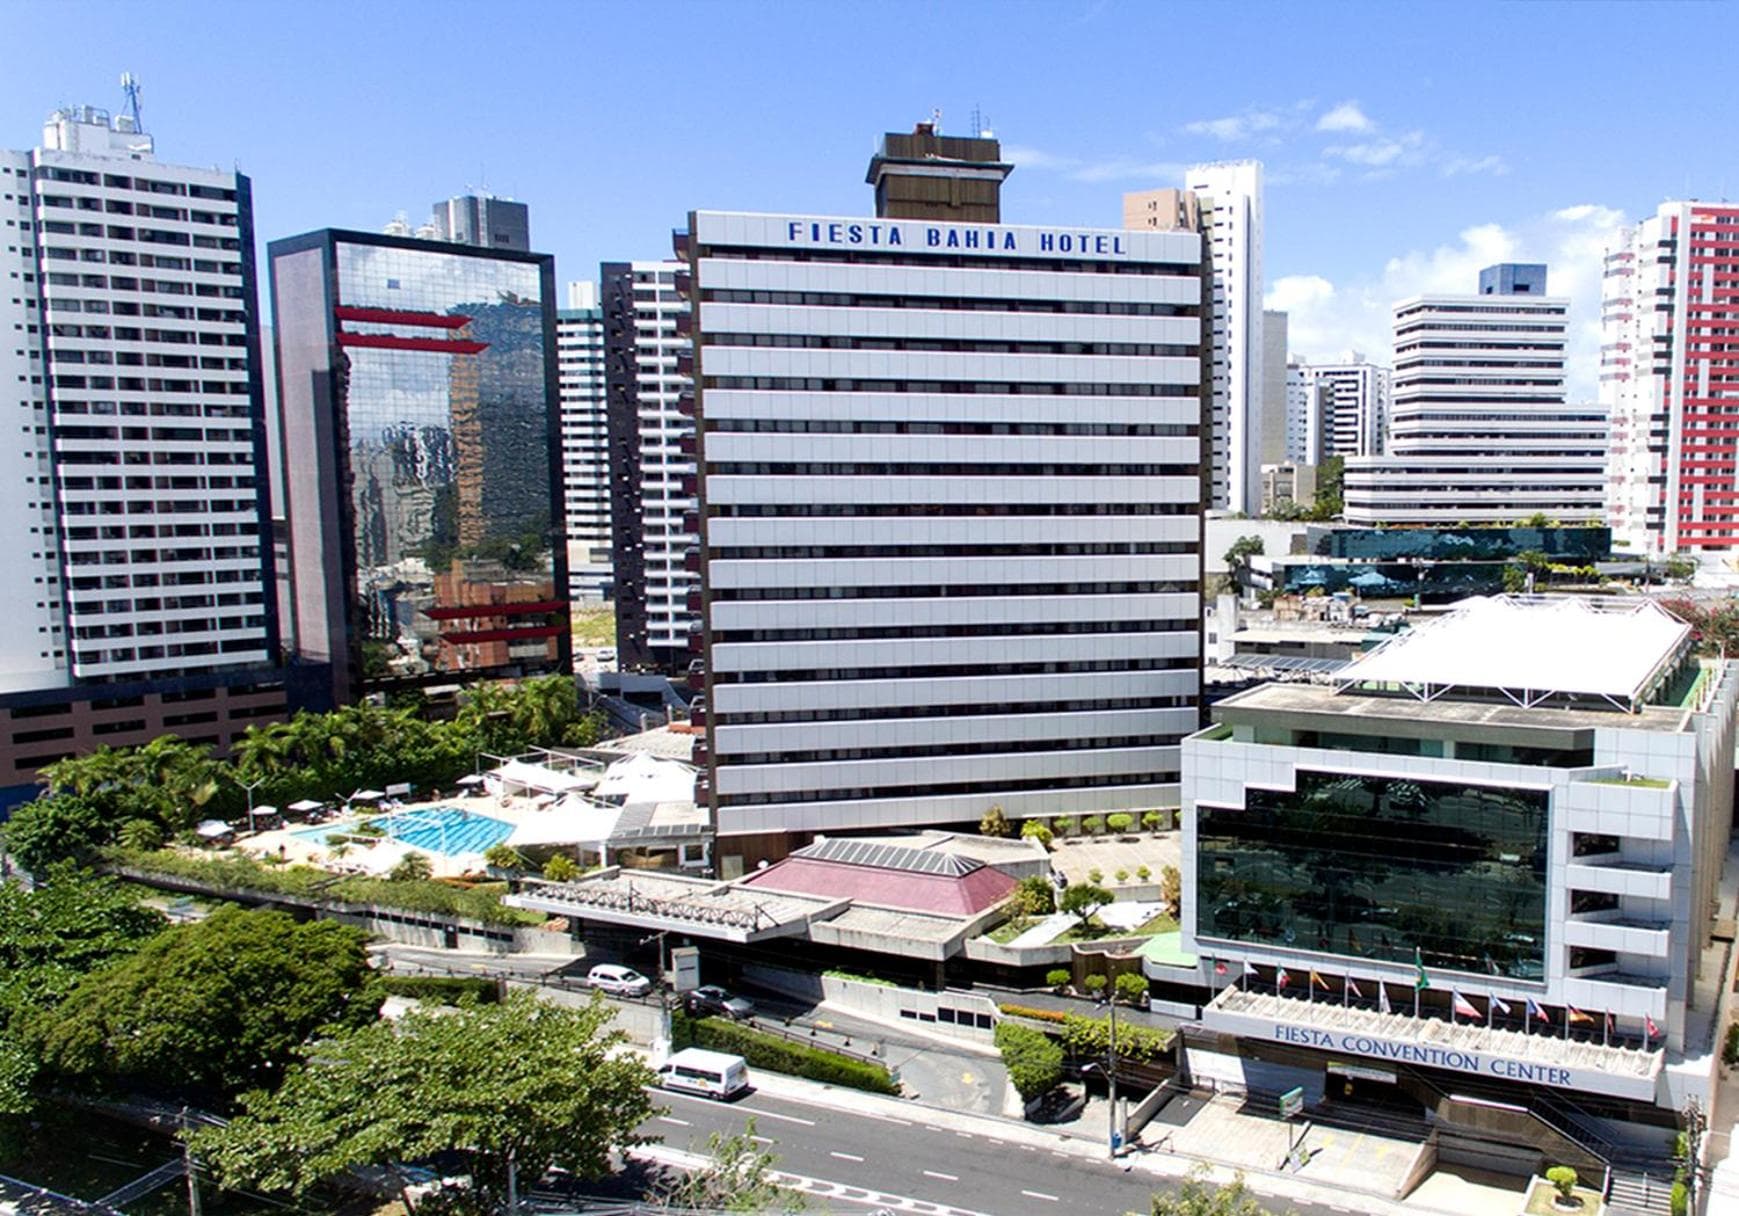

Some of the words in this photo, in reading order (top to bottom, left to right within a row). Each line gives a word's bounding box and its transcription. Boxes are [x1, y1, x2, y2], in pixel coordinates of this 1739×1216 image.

[788, 221, 902, 246] FIESTA
[927, 228, 1017, 250] BAHIA
[1041, 233, 1126, 255] HOTEL
[1275, 1025, 1334, 1048] FIESTA
[1342, 1039, 1479, 1072] CONVENTION
[1490, 1059, 1572, 1086] CENTER
